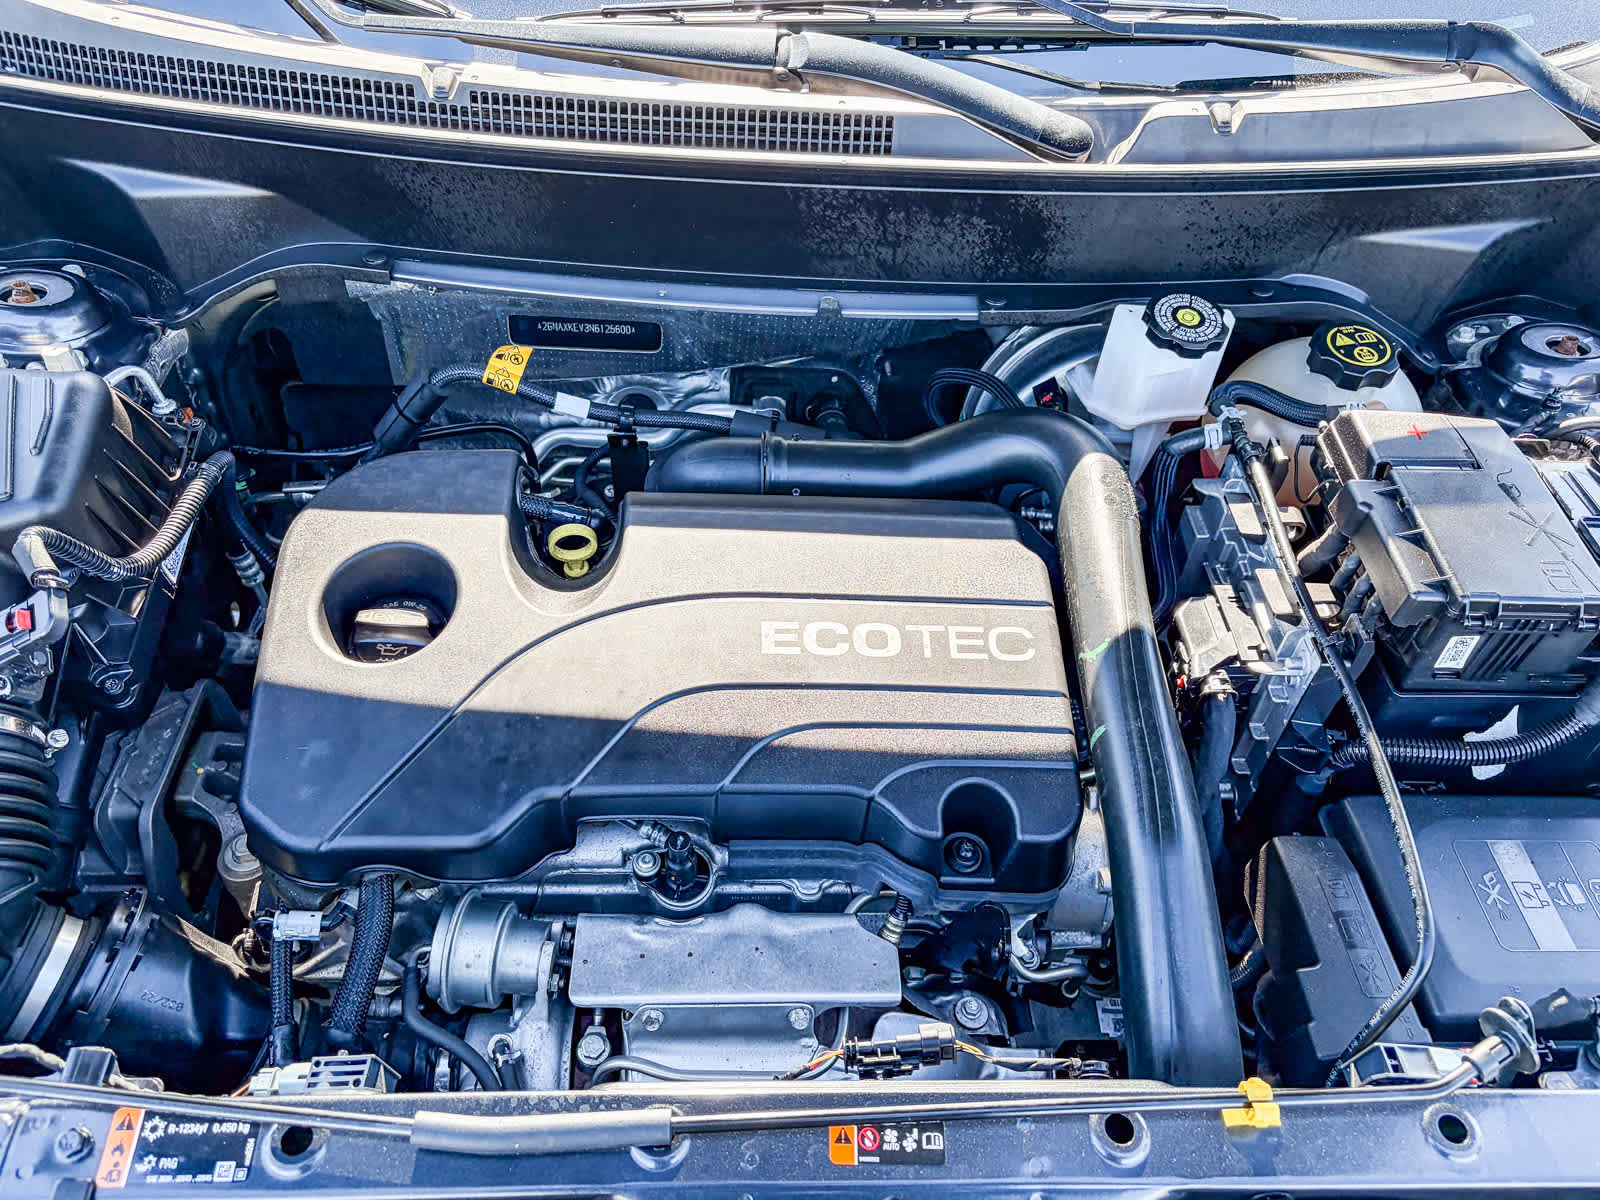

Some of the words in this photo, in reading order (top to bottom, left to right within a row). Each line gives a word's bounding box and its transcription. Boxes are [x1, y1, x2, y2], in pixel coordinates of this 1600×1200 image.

[760, 620, 1036, 662] ECOTEC
[238, 1123, 251, 1136] kg
[882, 1142, 901, 1151] AUTO
[158, 1157, 179, 1170] PAG
